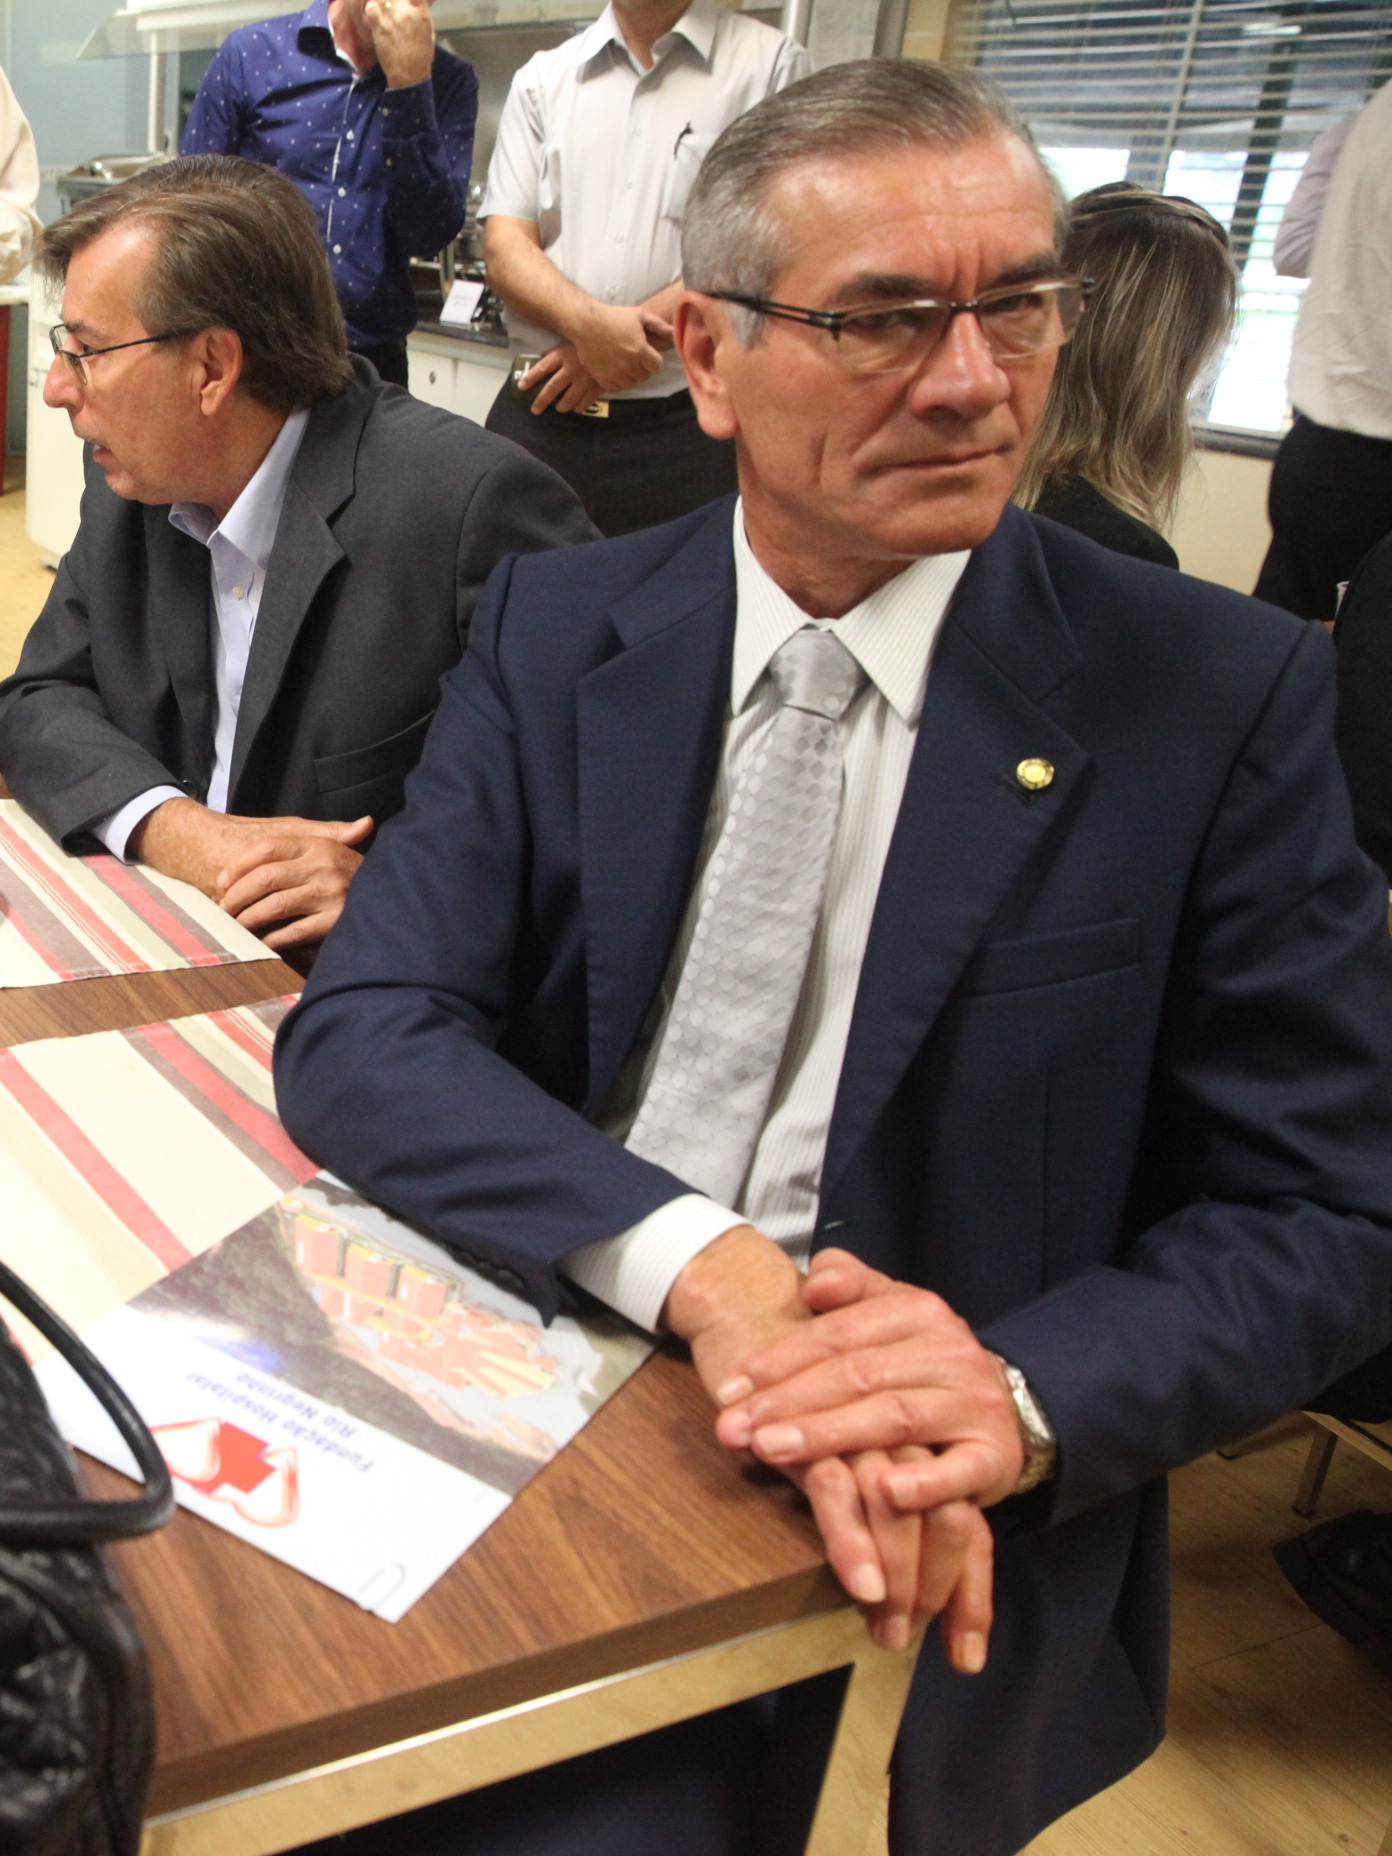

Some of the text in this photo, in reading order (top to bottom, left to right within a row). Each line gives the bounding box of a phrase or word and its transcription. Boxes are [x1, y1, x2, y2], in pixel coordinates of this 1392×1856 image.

[185, 1372, 374, 1473] Fundação Hospitalar
[236, 1372, 357, 1439] Rio Negrinho
